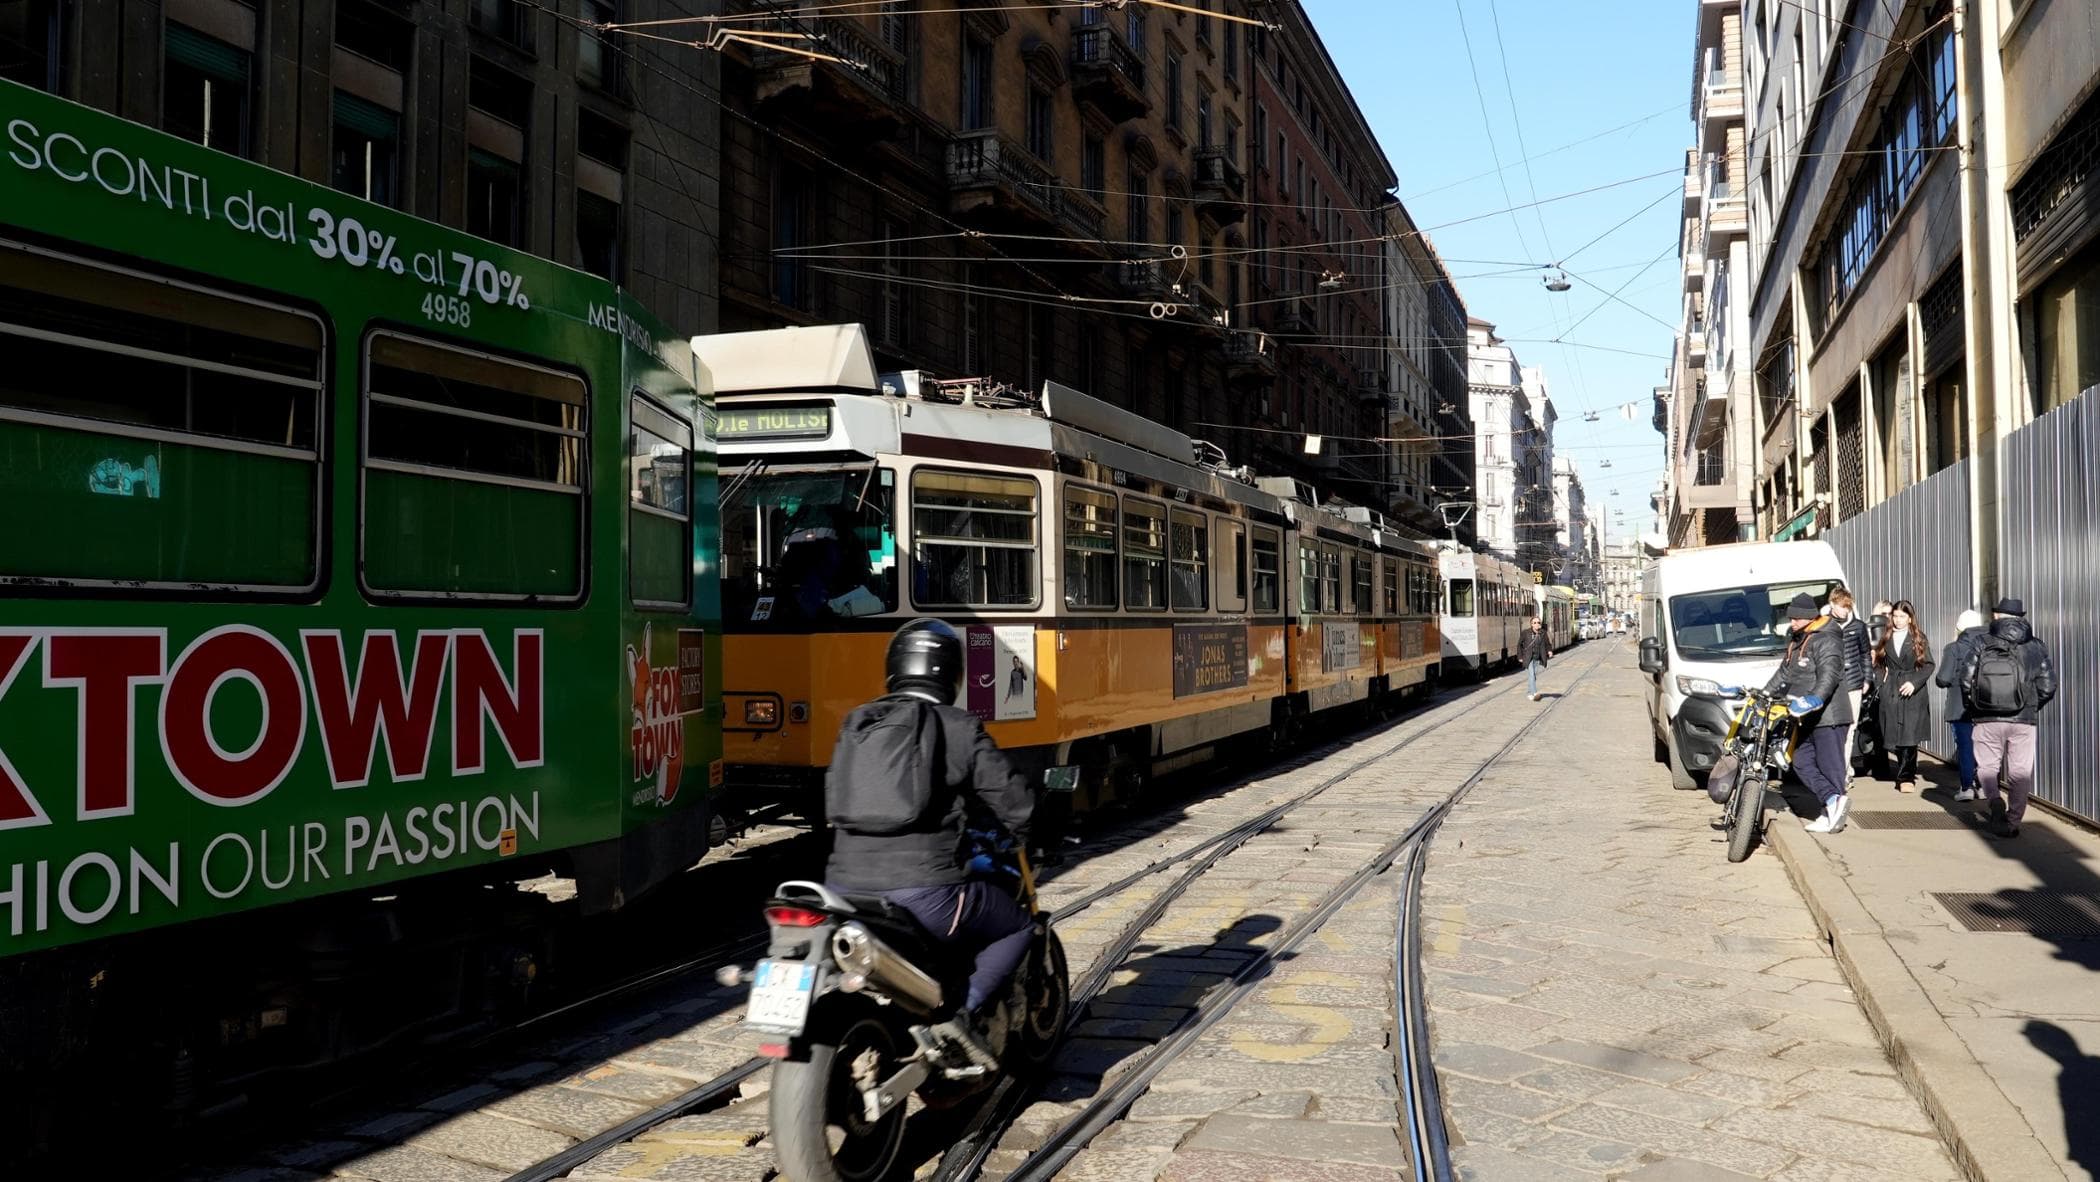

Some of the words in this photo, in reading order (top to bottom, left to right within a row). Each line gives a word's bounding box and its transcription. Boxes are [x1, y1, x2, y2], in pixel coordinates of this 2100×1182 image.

[7, 118, 211, 220] SCONTI
[224, 189, 296, 245] dal
[307, 207, 405, 277] 30%
[413, 248, 444, 287] al
[451, 251, 530, 311] 70%
[421, 292, 471, 328] 4958
[1195, 663, 1232, 689] BROTHERS
[1200, 644, 1226, 666] JONAS
[651, 666, 682, 719] FOX
[632, 716, 684, 783] TOWN
[200, 822, 332, 899] OUR
[344, 790, 539, 876] PASSION
